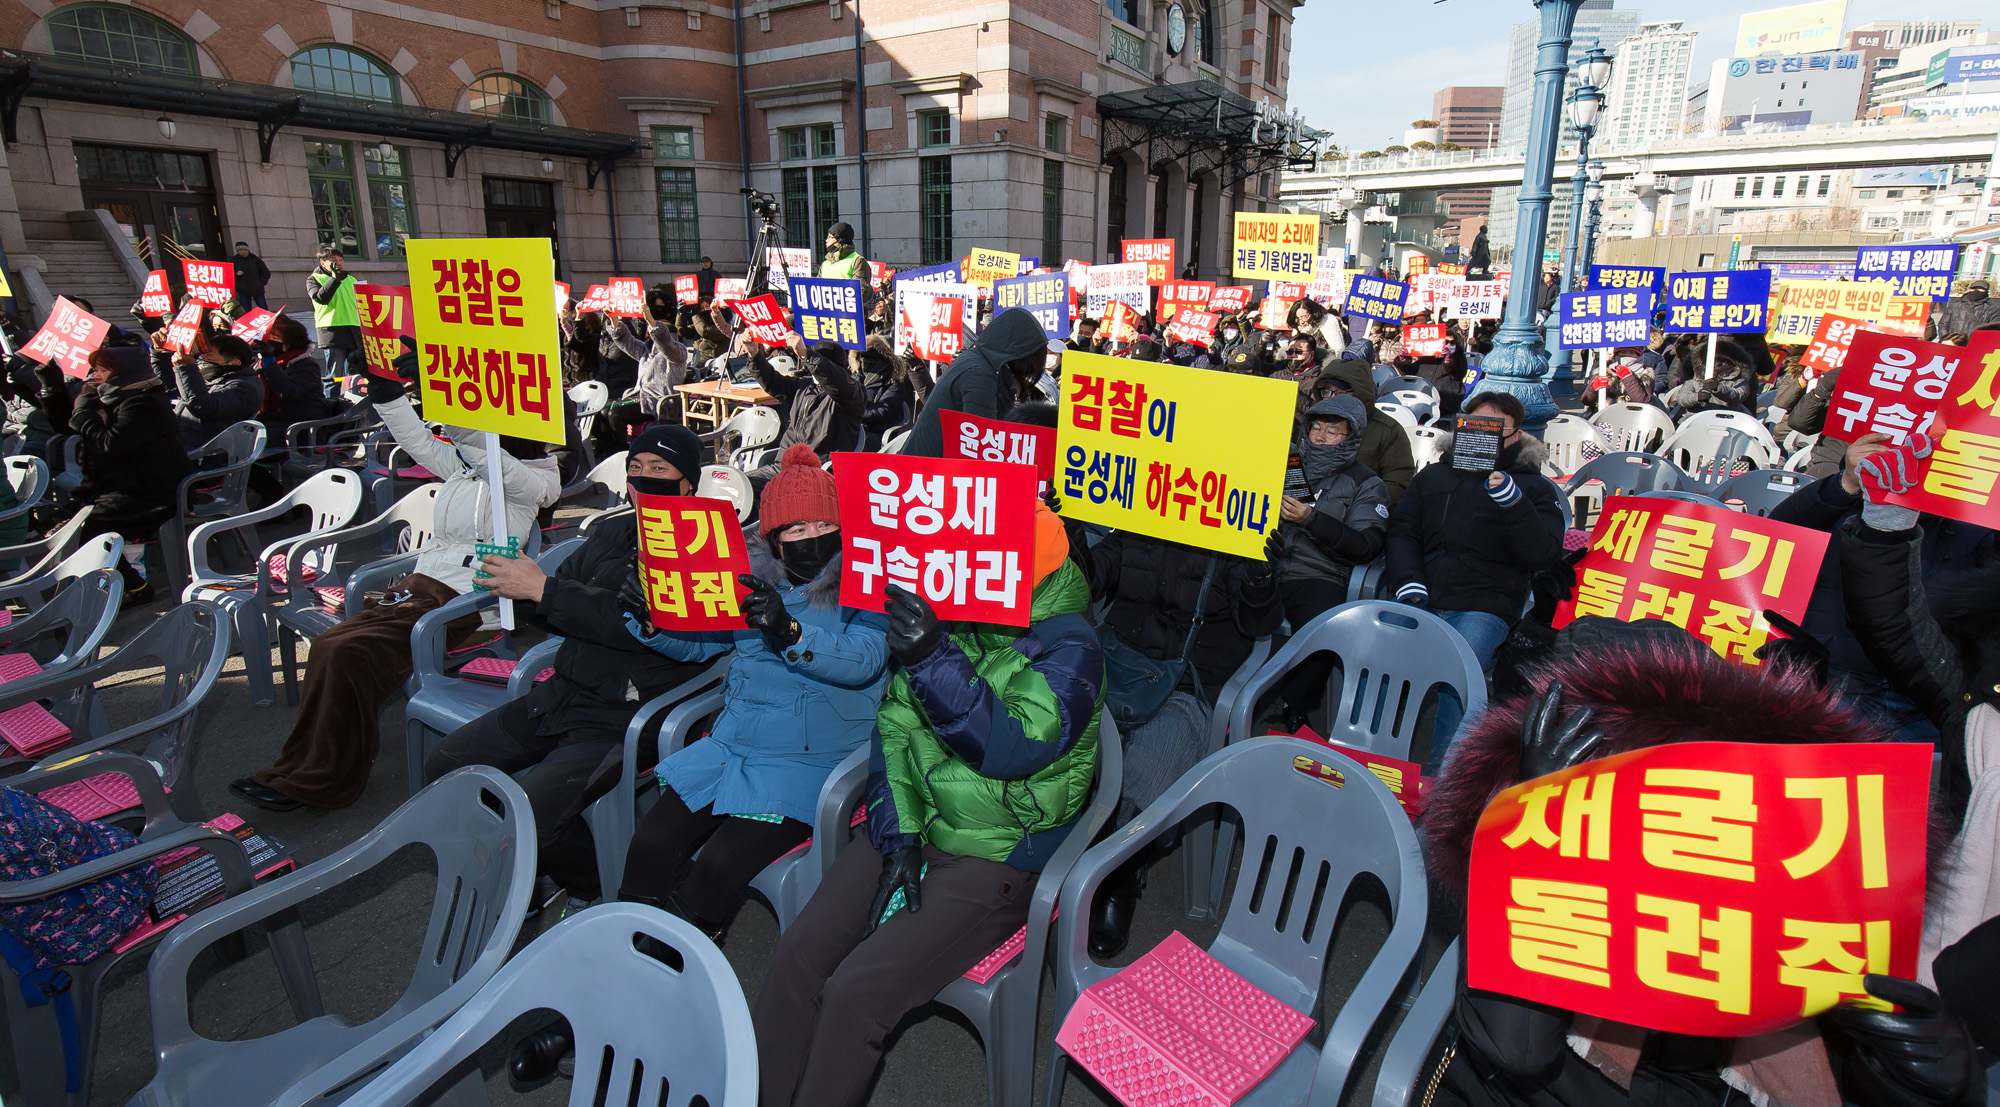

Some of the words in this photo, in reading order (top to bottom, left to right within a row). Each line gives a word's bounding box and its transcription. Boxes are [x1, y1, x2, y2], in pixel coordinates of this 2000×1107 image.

[1755, 54, 1859, 74] 한진택배
[1238, 221, 1278, 244] 피해자의
[1282, 223, 1315, 246] 소리에
[978, 254, 1011, 270] 윤성재는
[1237, 249, 1256, 270] 귀를
[1260, 251, 1313, 274] 기울여달라
[1440, 264, 1464, 274] 채굴기
[1859, 251, 1889, 271] 사건의
[1912, 249, 1955, 272] 윤성재를
[187, 263, 223, 284] 윤성재
[676, 277, 694, 291] 윤성재
[1598, 269, 1654, 288] 부장검사
[432, 259, 524, 327] 검찰은
[615, 280, 639, 296] 윤성재
[795, 284, 809, 309] 내
[810, 284, 857, 313] 이더리움
[998, 283, 1025, 308] 채굴기
[1027, 278, 1065, 306] 불법점유
[1163, 285, 1174, 300] 내
[1177, 285, 1211, 302] 채굴기
[1214, 288, 1244, 300] 윤성재
[1297, 282, 1330, 292] 천지검
[1358, 278, 1383, 297] 윤성재를
[1434, 292, 1449, 303] 구속
[1452, 285, 1480, 298] 채굴기
[1483, 284, 1501, 297] 도둑
[1672, 277, 1705, 299] 이제
[1712, 276, 1729, 298] 곧
[609, 298, 643, 314] 구속하라
[1208, 299, 1243, 310] 구속하라
[1347, 295, 1367, 313] 못하는
[1366, 299, 1385, 317] 이유는
[1459, 301, 1490, 315] 윤성재
[1571, 294, 1602, 317] 도둑
[1606, 293, 1638, 315] 비호
[1781, 287, 1840, 310] 4차산업의
[1845, 289, 1885, 312] 핵심인
[929, 303, 952, 328] 성재
[1180, 309, 1212, 328] 윤성재
[1670, 305, 1705, 327] 자살
[1709, 303, 1762, 327] 뿐인가
[746, 321, 788, 343] 속하라
[801, 315, 858, 344] 돌려줘
[1168, 321, 1210, 343] 구속하라
[1410, 327, 1439, 340] 윤성재
[1562, 321, 1602, 345] 인천검찰
[1604, 318, 1648, 342] 각성하라
[424, 343, 552, 421] 각성하라
[1070, 373, 1177, 443] 검찰이
[958, 421, 1037, 465] 윤성재
[1063, 444, 1137, 510] 윤성재
[1145, 461, 1271, 535] 하수인이냐
[867, 467, 997, 536] 윤성재
[637, 504, 731, 559] 굴기
[1593, 508, 1796, 599] 채굴기
[851, 536, 1022, 609] 구속하라
[1574, 566, 1774, 666] 돌려줘
[1501, 768, 1890, 890] 채굴기
[1506, 877, 1894, 1018] 돌려줘
